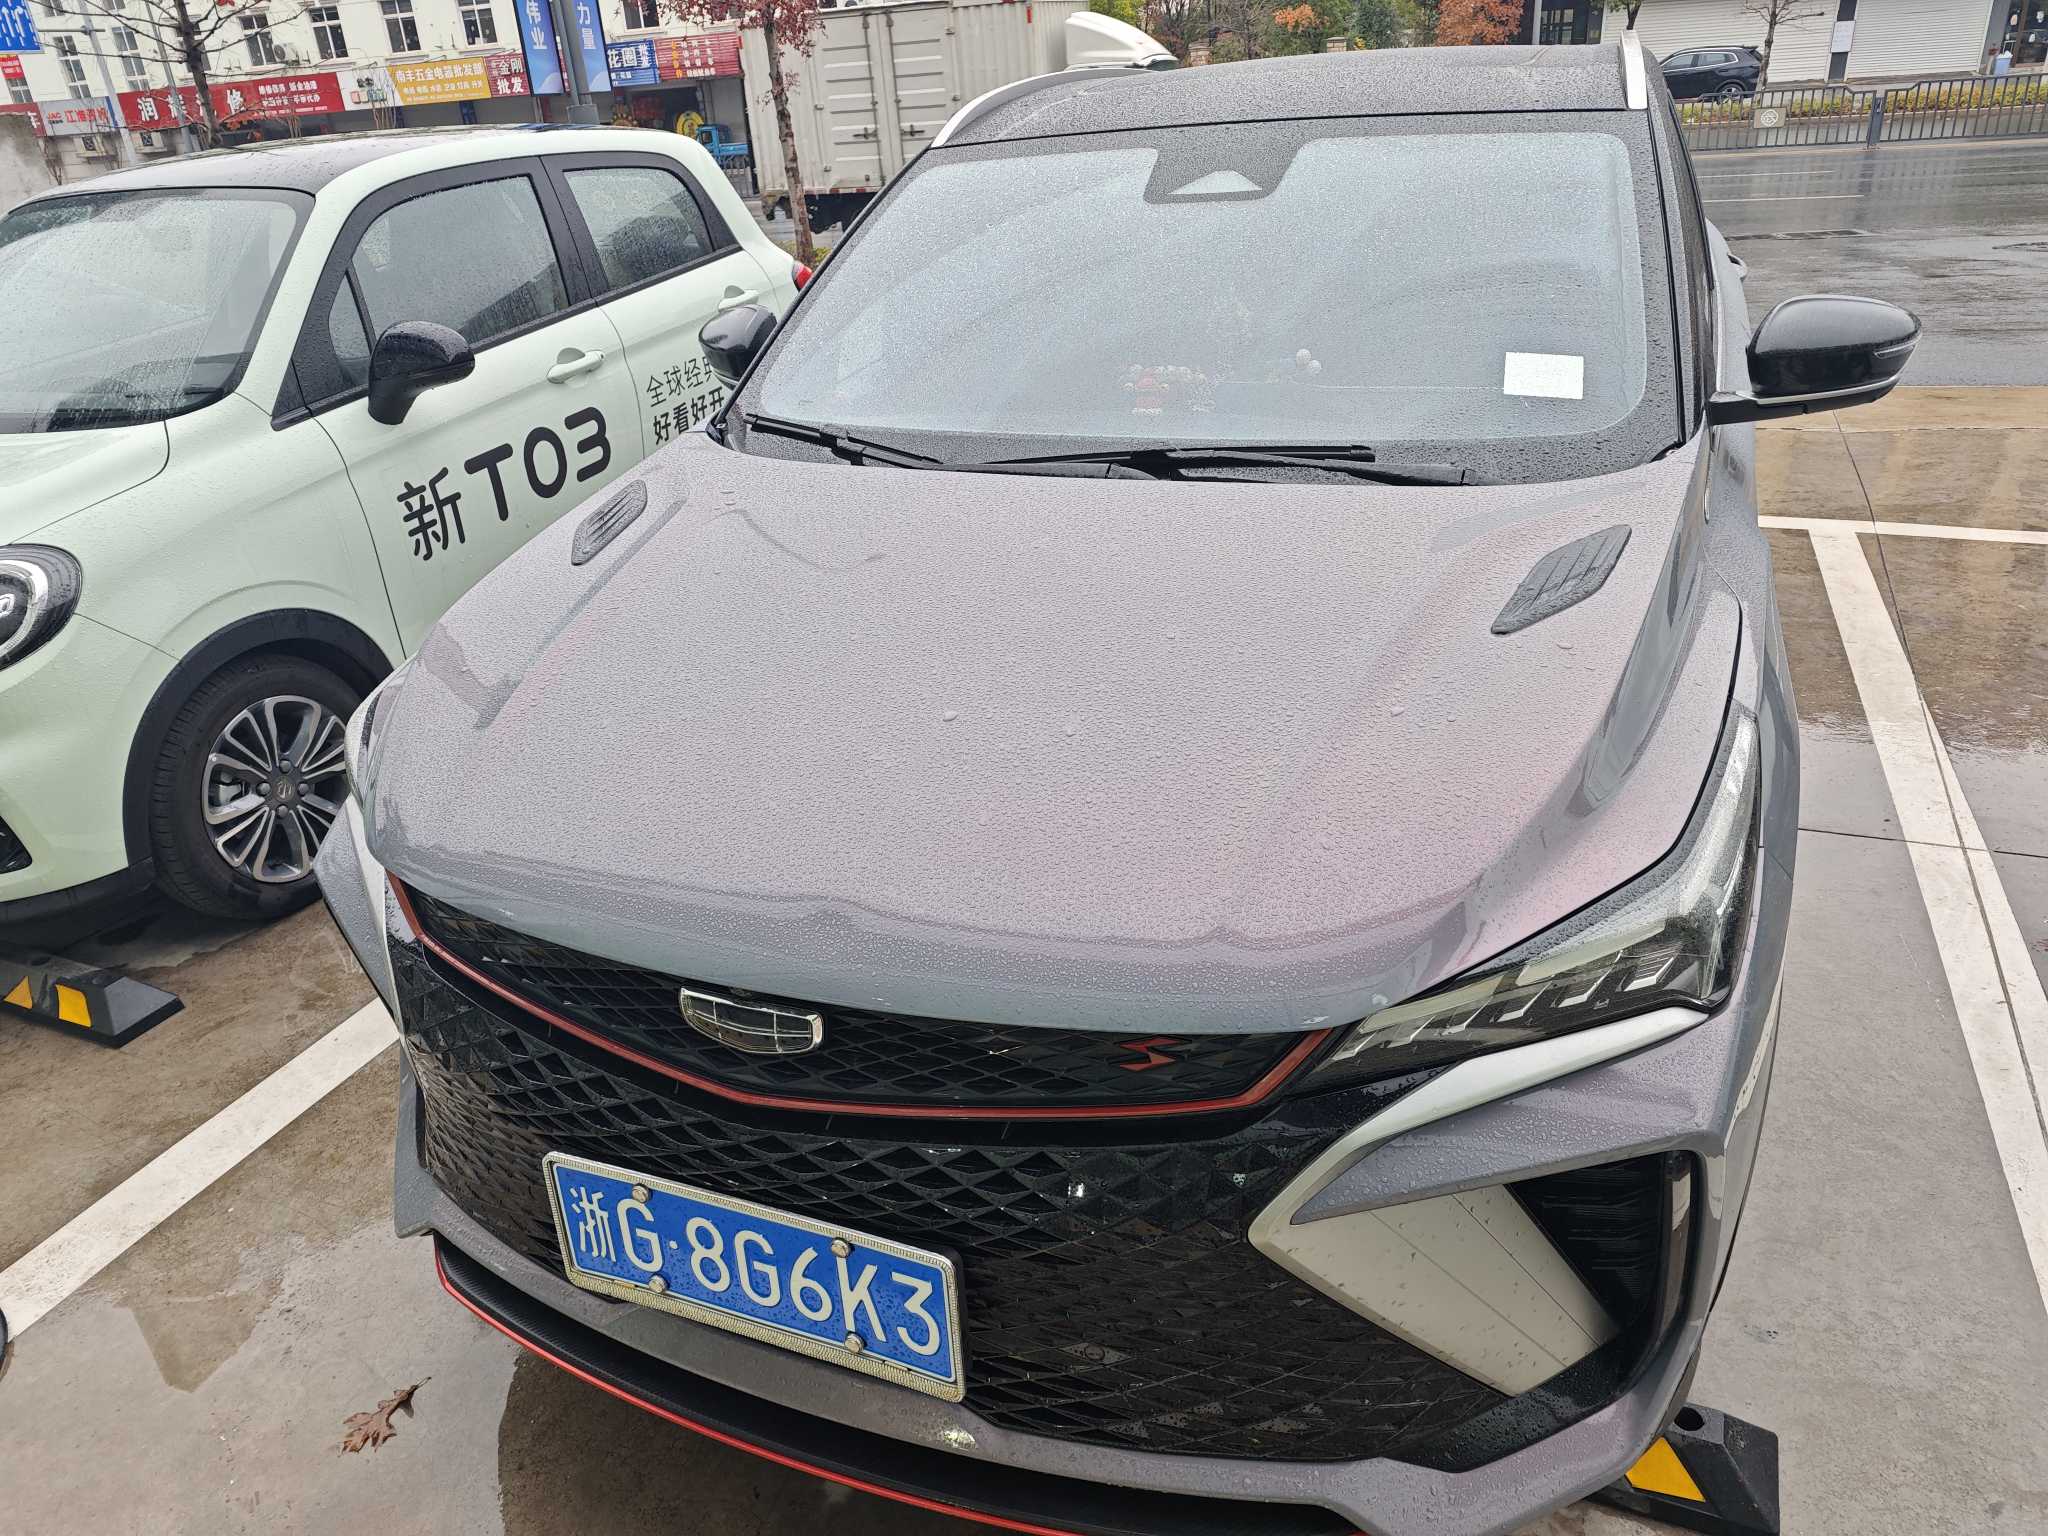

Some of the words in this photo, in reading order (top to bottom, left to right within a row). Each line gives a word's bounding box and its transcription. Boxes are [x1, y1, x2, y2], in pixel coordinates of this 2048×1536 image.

[576, 2, 597, 49] 力量
[497, 76, 524, 94] 批发
[653, 386, 725, 446] 好看好开
